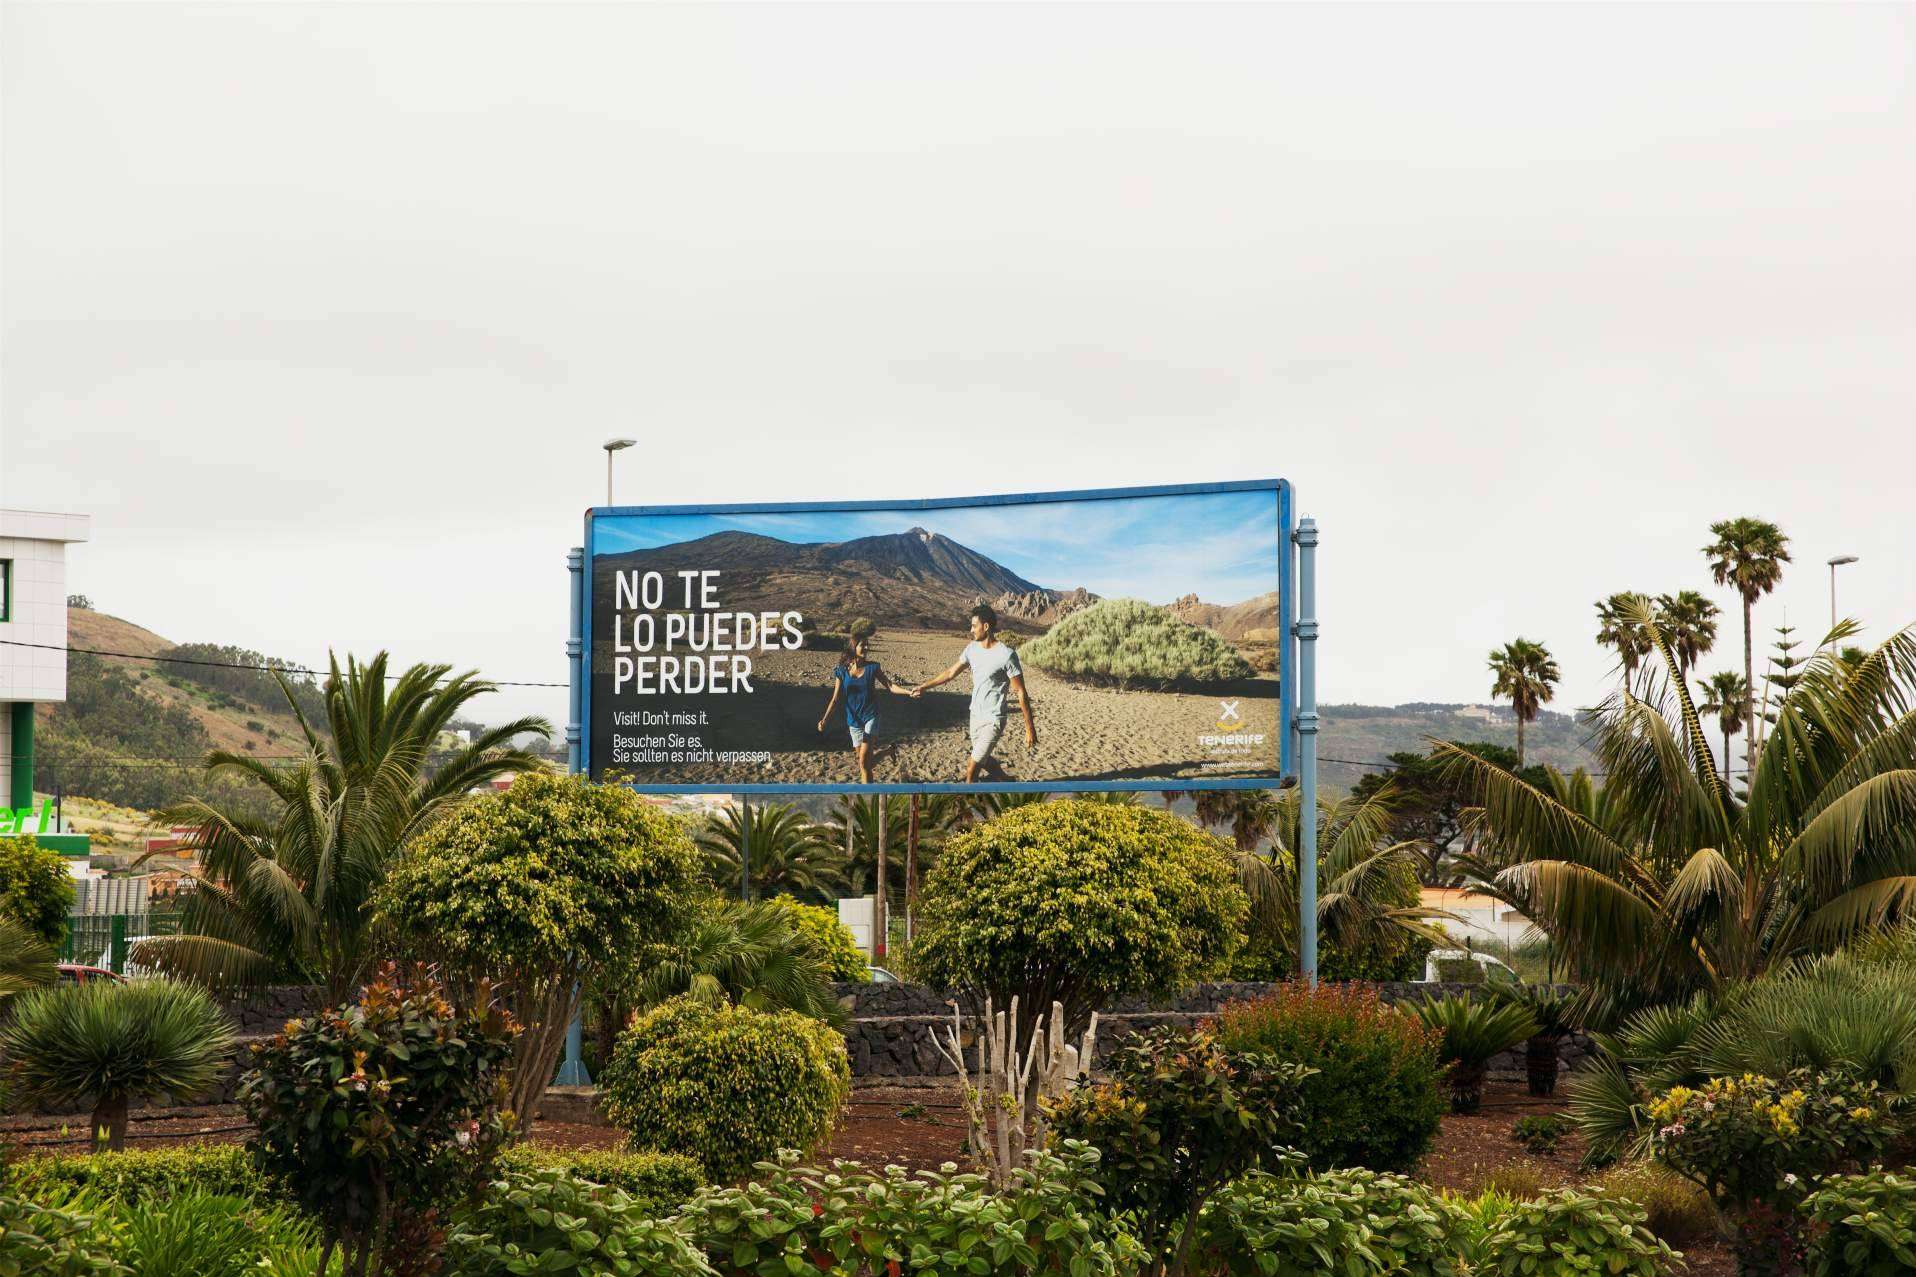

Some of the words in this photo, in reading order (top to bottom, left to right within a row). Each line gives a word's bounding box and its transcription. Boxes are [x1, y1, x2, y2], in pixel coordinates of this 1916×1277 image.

[615, 570, 664, 610] NO
[678, 570, 721, 609] TE
[614, 613, 655, 653] LO
[666, 611, 803, 652] PUEDES
[614, 655, 754, 695] PERDER
[613, 711, 640, 726] Visit!
[642, 710, 670, 726] Don't
[672, 711, 697, 725] miss
[699, 711, 709, 725] it.
[613, 733, 666, 748] Besuchen
[668, 733, 685, 748] Sie
[687, 737, 703, 748] es.
[613, 749, 630, 763] Sie
[632, 749, 669, 763] sollten
[671, 751, 684, 763] es
[686, 748, 713, 763] nicht
[716, 750, 773, 766] verpassen.
